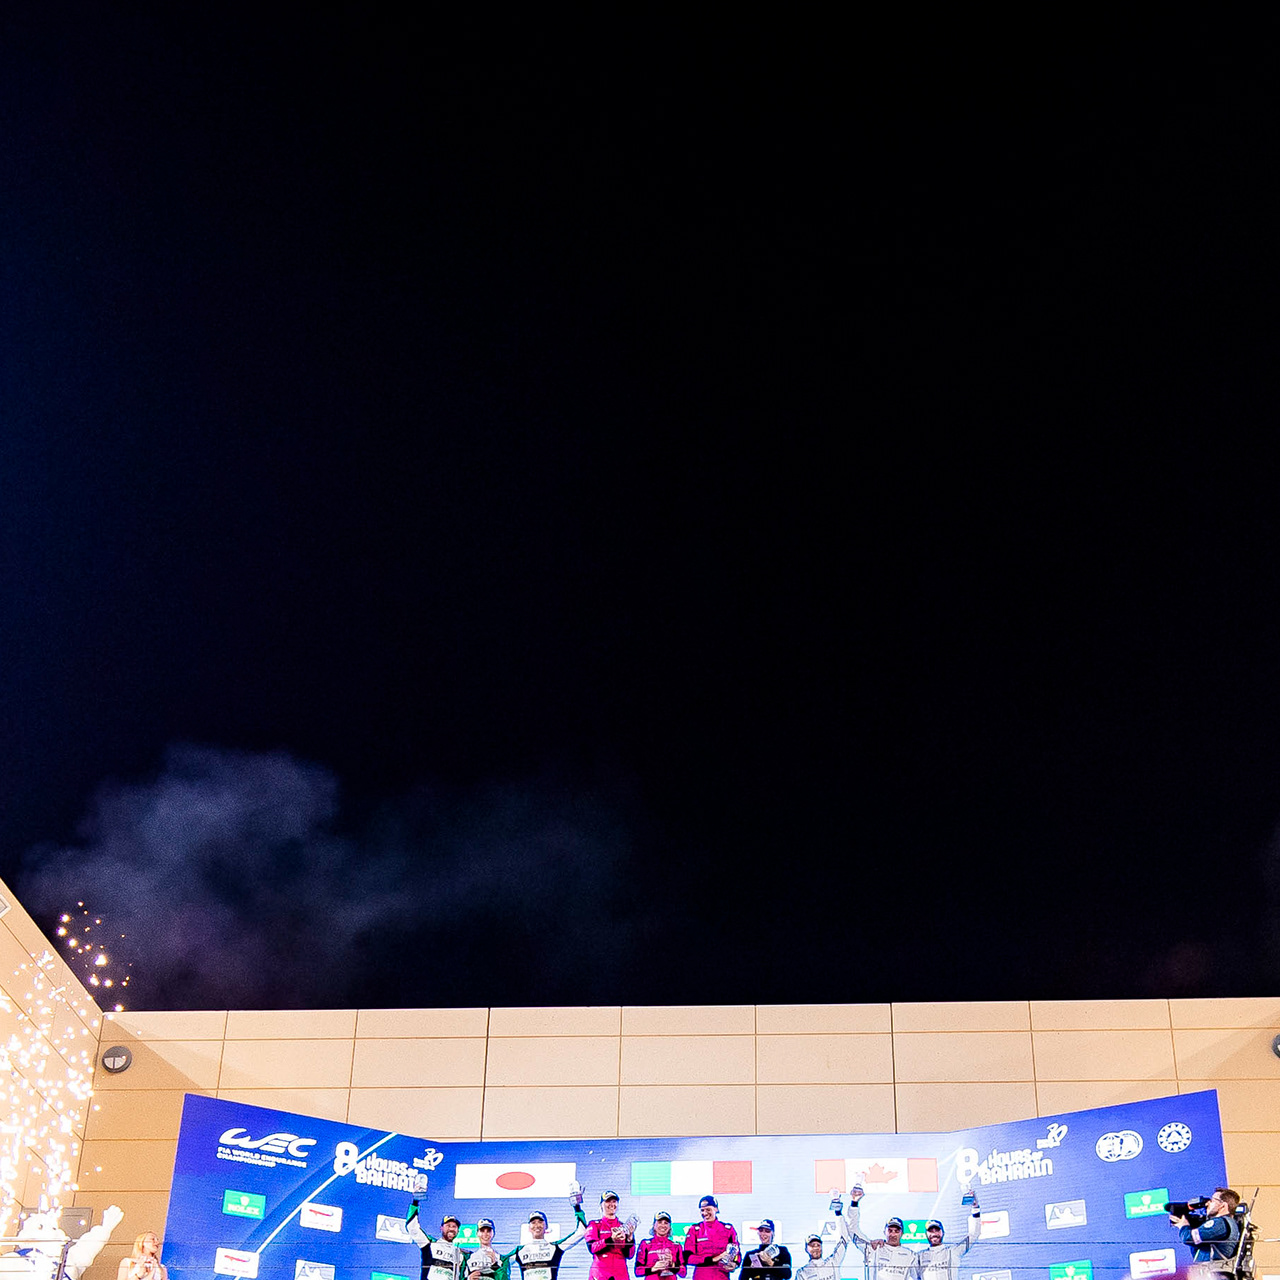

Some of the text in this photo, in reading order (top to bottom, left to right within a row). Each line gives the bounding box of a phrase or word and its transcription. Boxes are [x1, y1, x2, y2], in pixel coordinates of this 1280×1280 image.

[219, 1127, 317, 1158] WEC
[333, 1141, 359, 1176] 8
[366, 1152, 408, 1176] HOURS
[955, 1148, 980, 1184] 8
[979, 1158, 1053, 1185] BAHRAIN
[987, 1148, 1032, 1168] HOURS
[356, 1167, 417, 1193] BAHRAI
